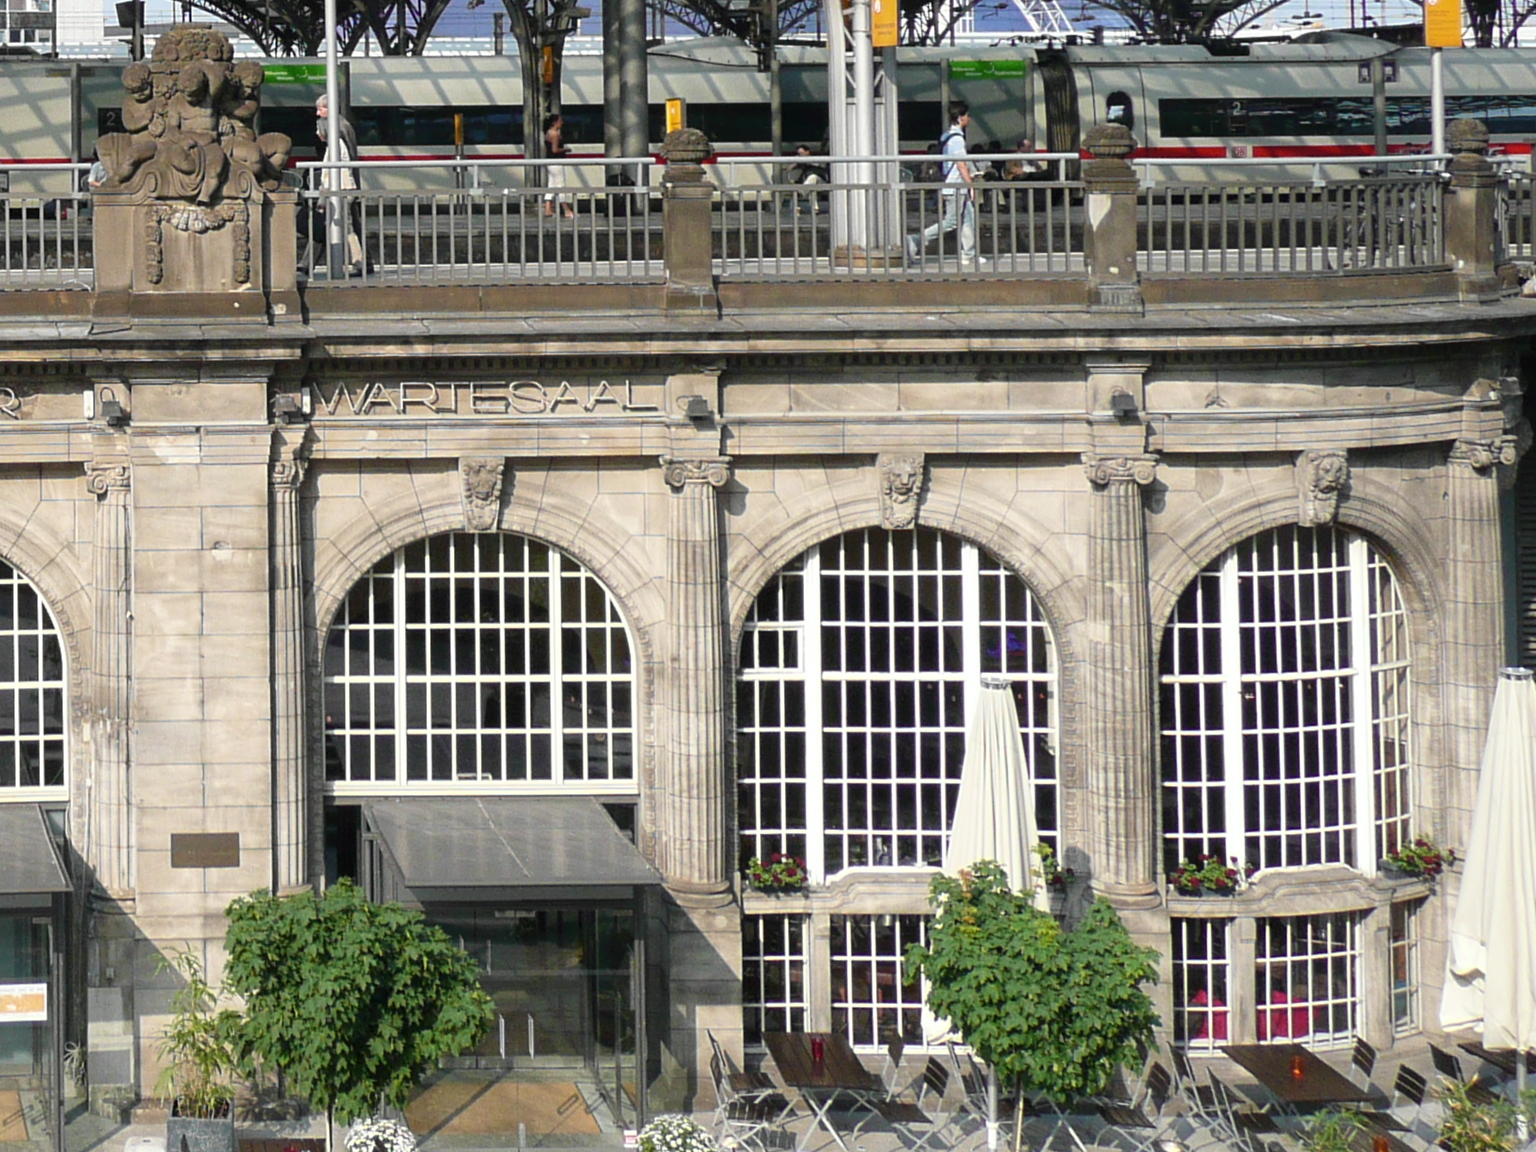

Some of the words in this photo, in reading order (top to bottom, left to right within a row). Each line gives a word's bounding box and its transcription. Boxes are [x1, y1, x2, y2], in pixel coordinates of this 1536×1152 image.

[1232, 101, 1243, 116] 2
[106, 111, 116, 126] 2
[313, 378, 660, 415] WARTESAAL
